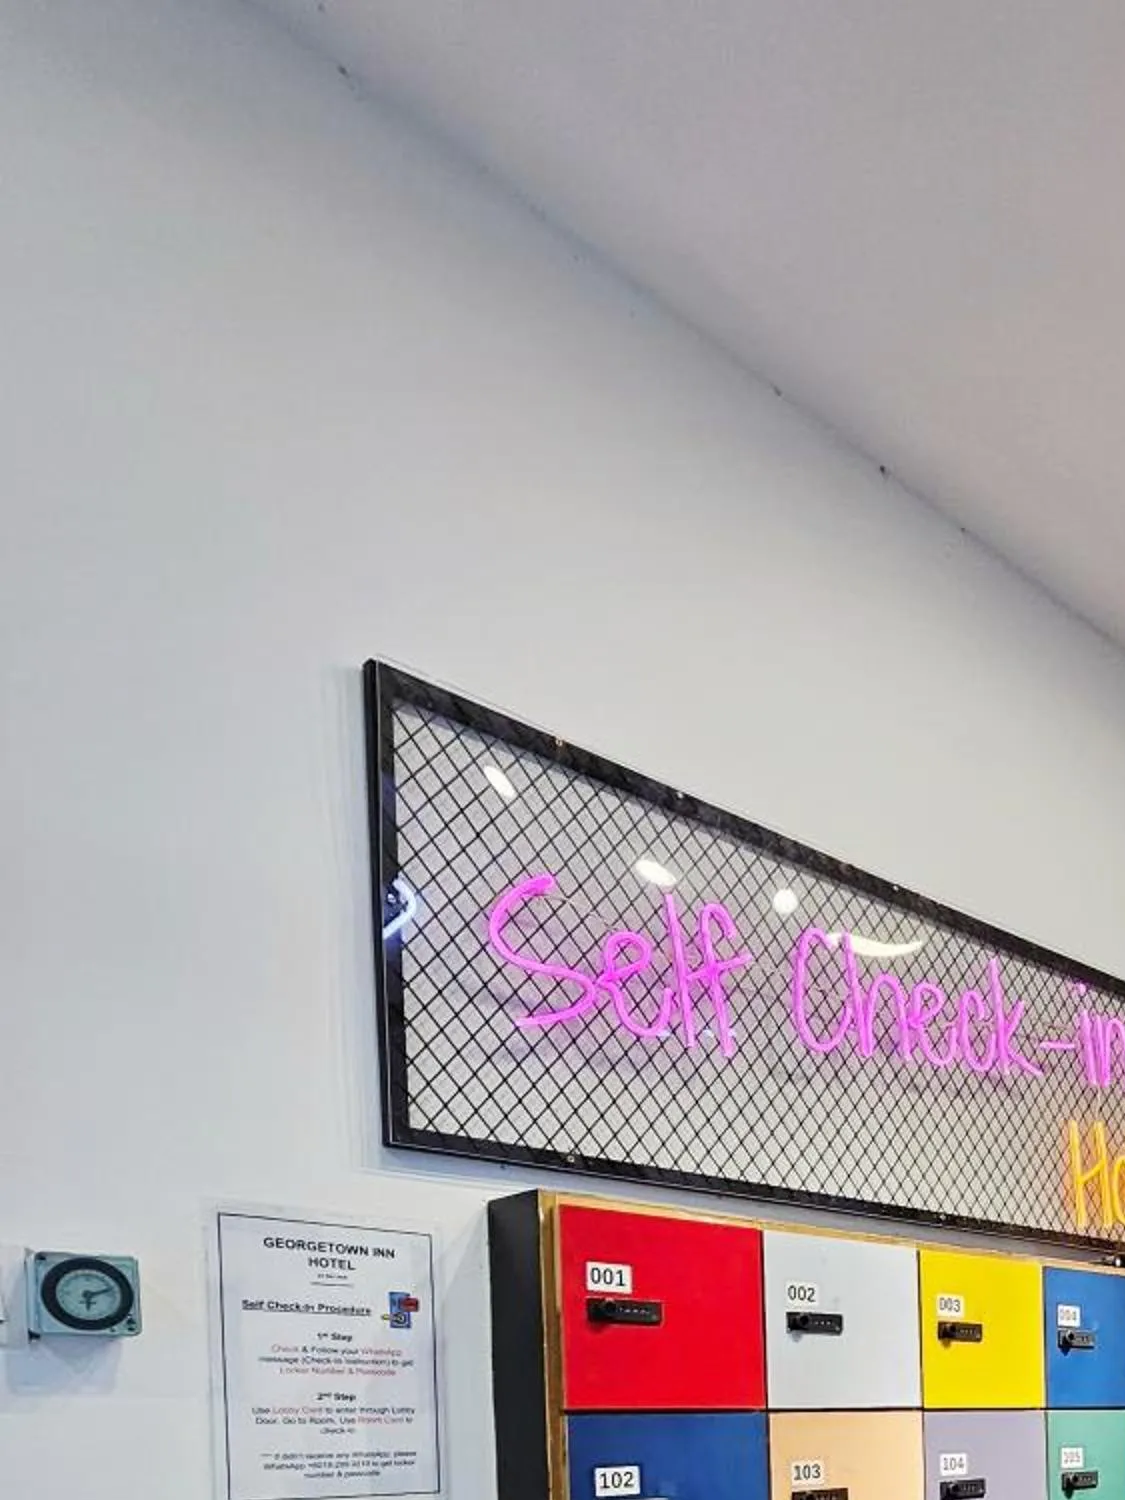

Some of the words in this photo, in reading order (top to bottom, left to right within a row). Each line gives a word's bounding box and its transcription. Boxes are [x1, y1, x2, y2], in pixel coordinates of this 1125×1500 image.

[487, 872, 751, 1057] Self
[263, 1236, 369, 1257] GEORGETOWN
[373, 1247, 396, 1259] INN
[308, 1256, 356, 1271] HOTEL
[590, 1267, 626, 1288] 001
[787, 1284, 817, 1303] 002
[242, 1299, 264, 1312] Self
[317, 1304, 372, 1317] Procedure
[938, 1297, 961, 1313] 003
[331, 1332, 353, 1343] Step
[333, 1392, 357, 1403] Step
[793, 1463, 821, 1481] 103
[942, 1457, 965, 1471] 104
[599, 1471, 634, 1489] 102
